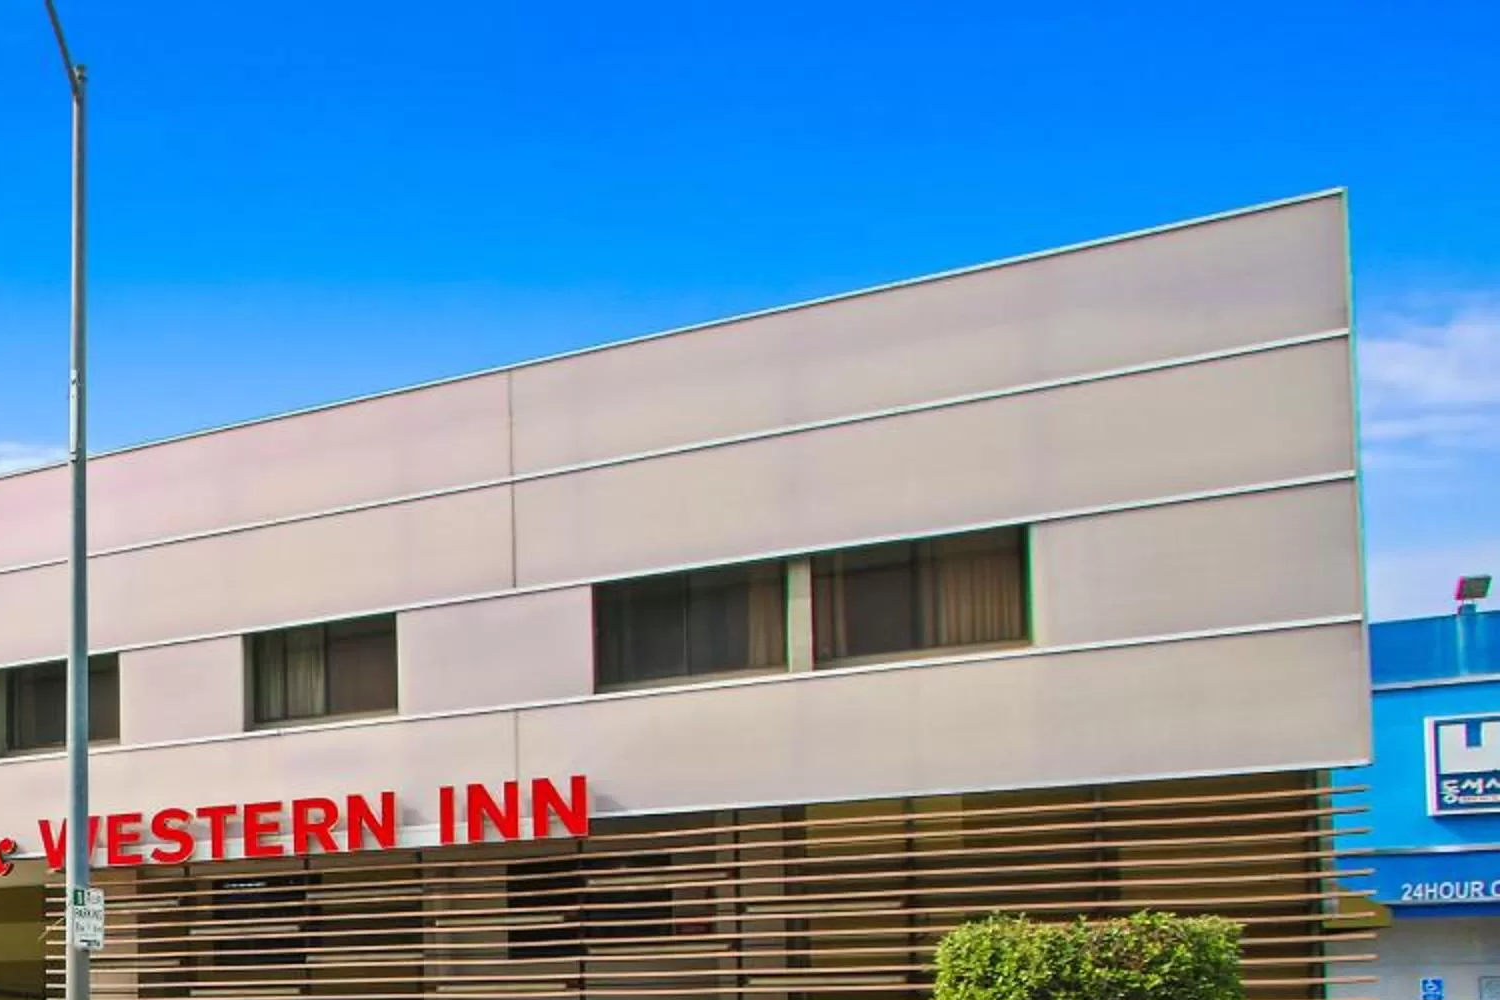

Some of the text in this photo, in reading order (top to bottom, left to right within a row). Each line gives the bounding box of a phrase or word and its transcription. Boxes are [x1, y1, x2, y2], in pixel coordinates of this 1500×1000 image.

[38, 791, 396, 871] WESTERN
[438, 775, 590, 846] INN
[1401, 881, 1485, 901] 24HOUR
